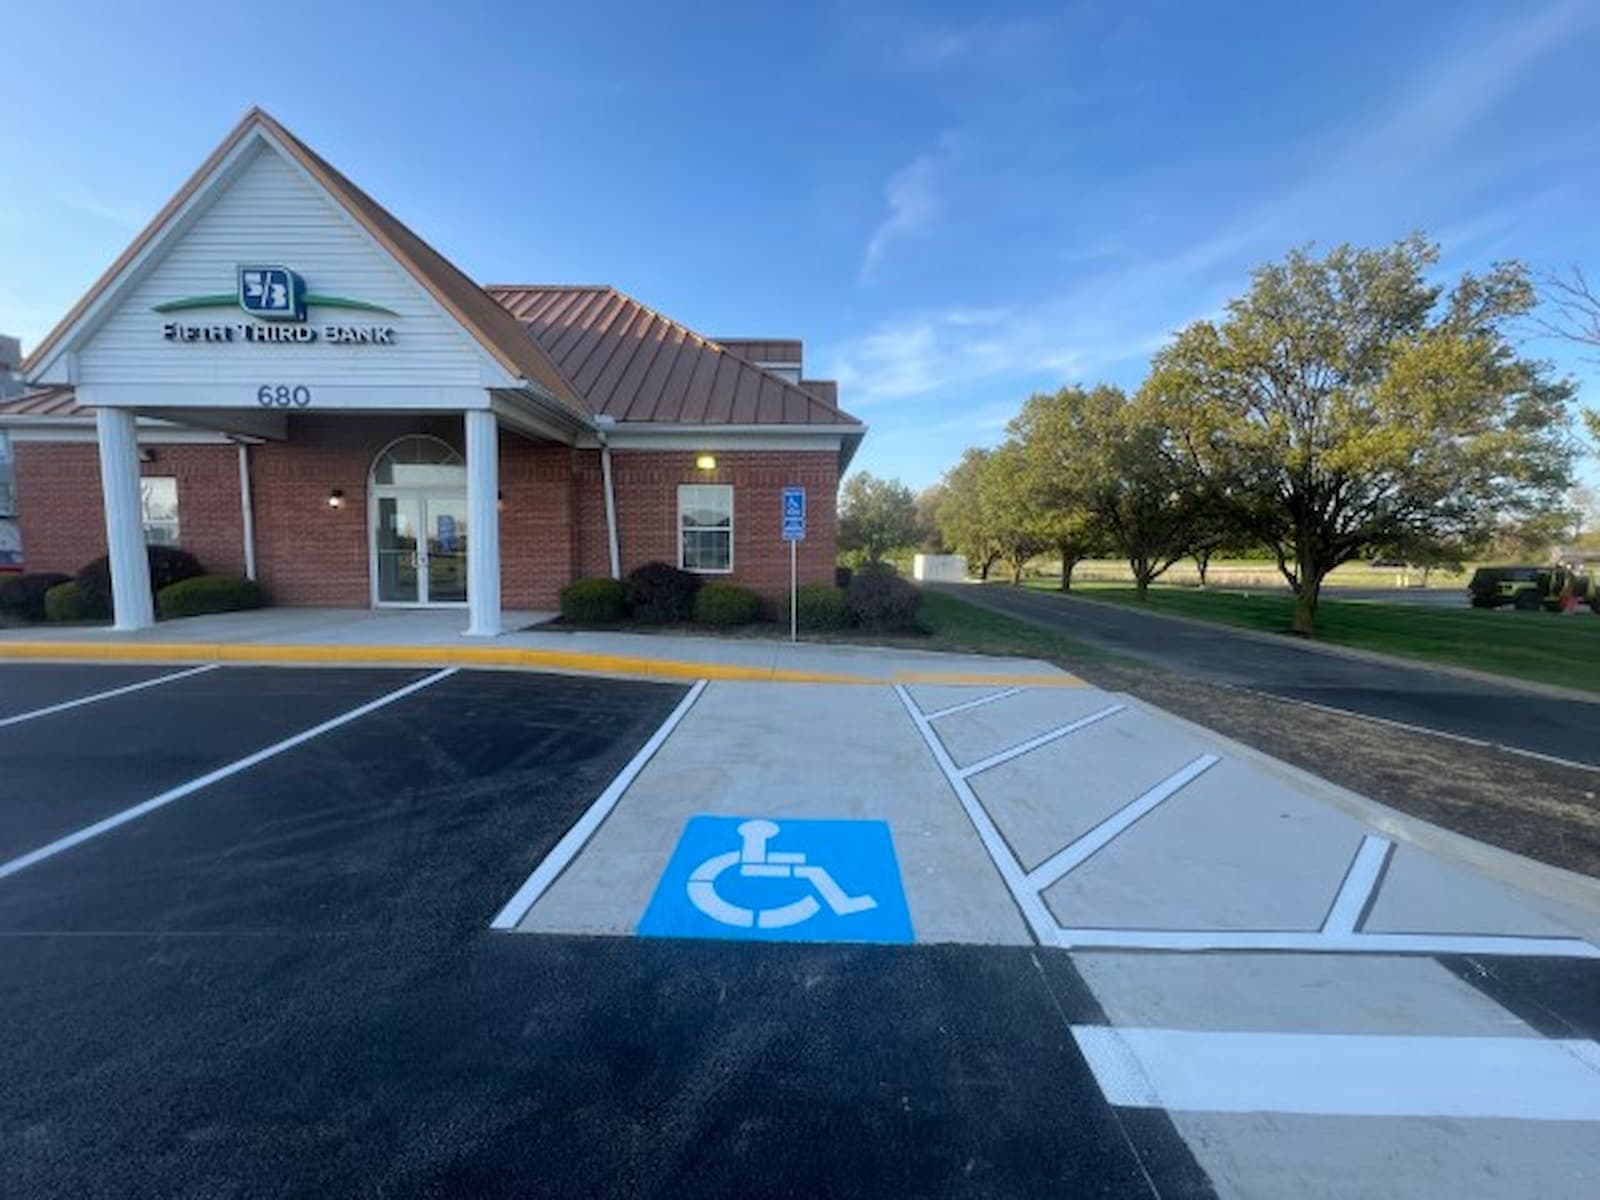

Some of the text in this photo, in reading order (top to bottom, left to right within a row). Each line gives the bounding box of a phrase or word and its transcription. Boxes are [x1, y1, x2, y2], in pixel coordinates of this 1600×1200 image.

[236, 322, 316, 342] THIRD
[321, 323, 392, 344] BANK
[257, 384, 310, 407] 680
